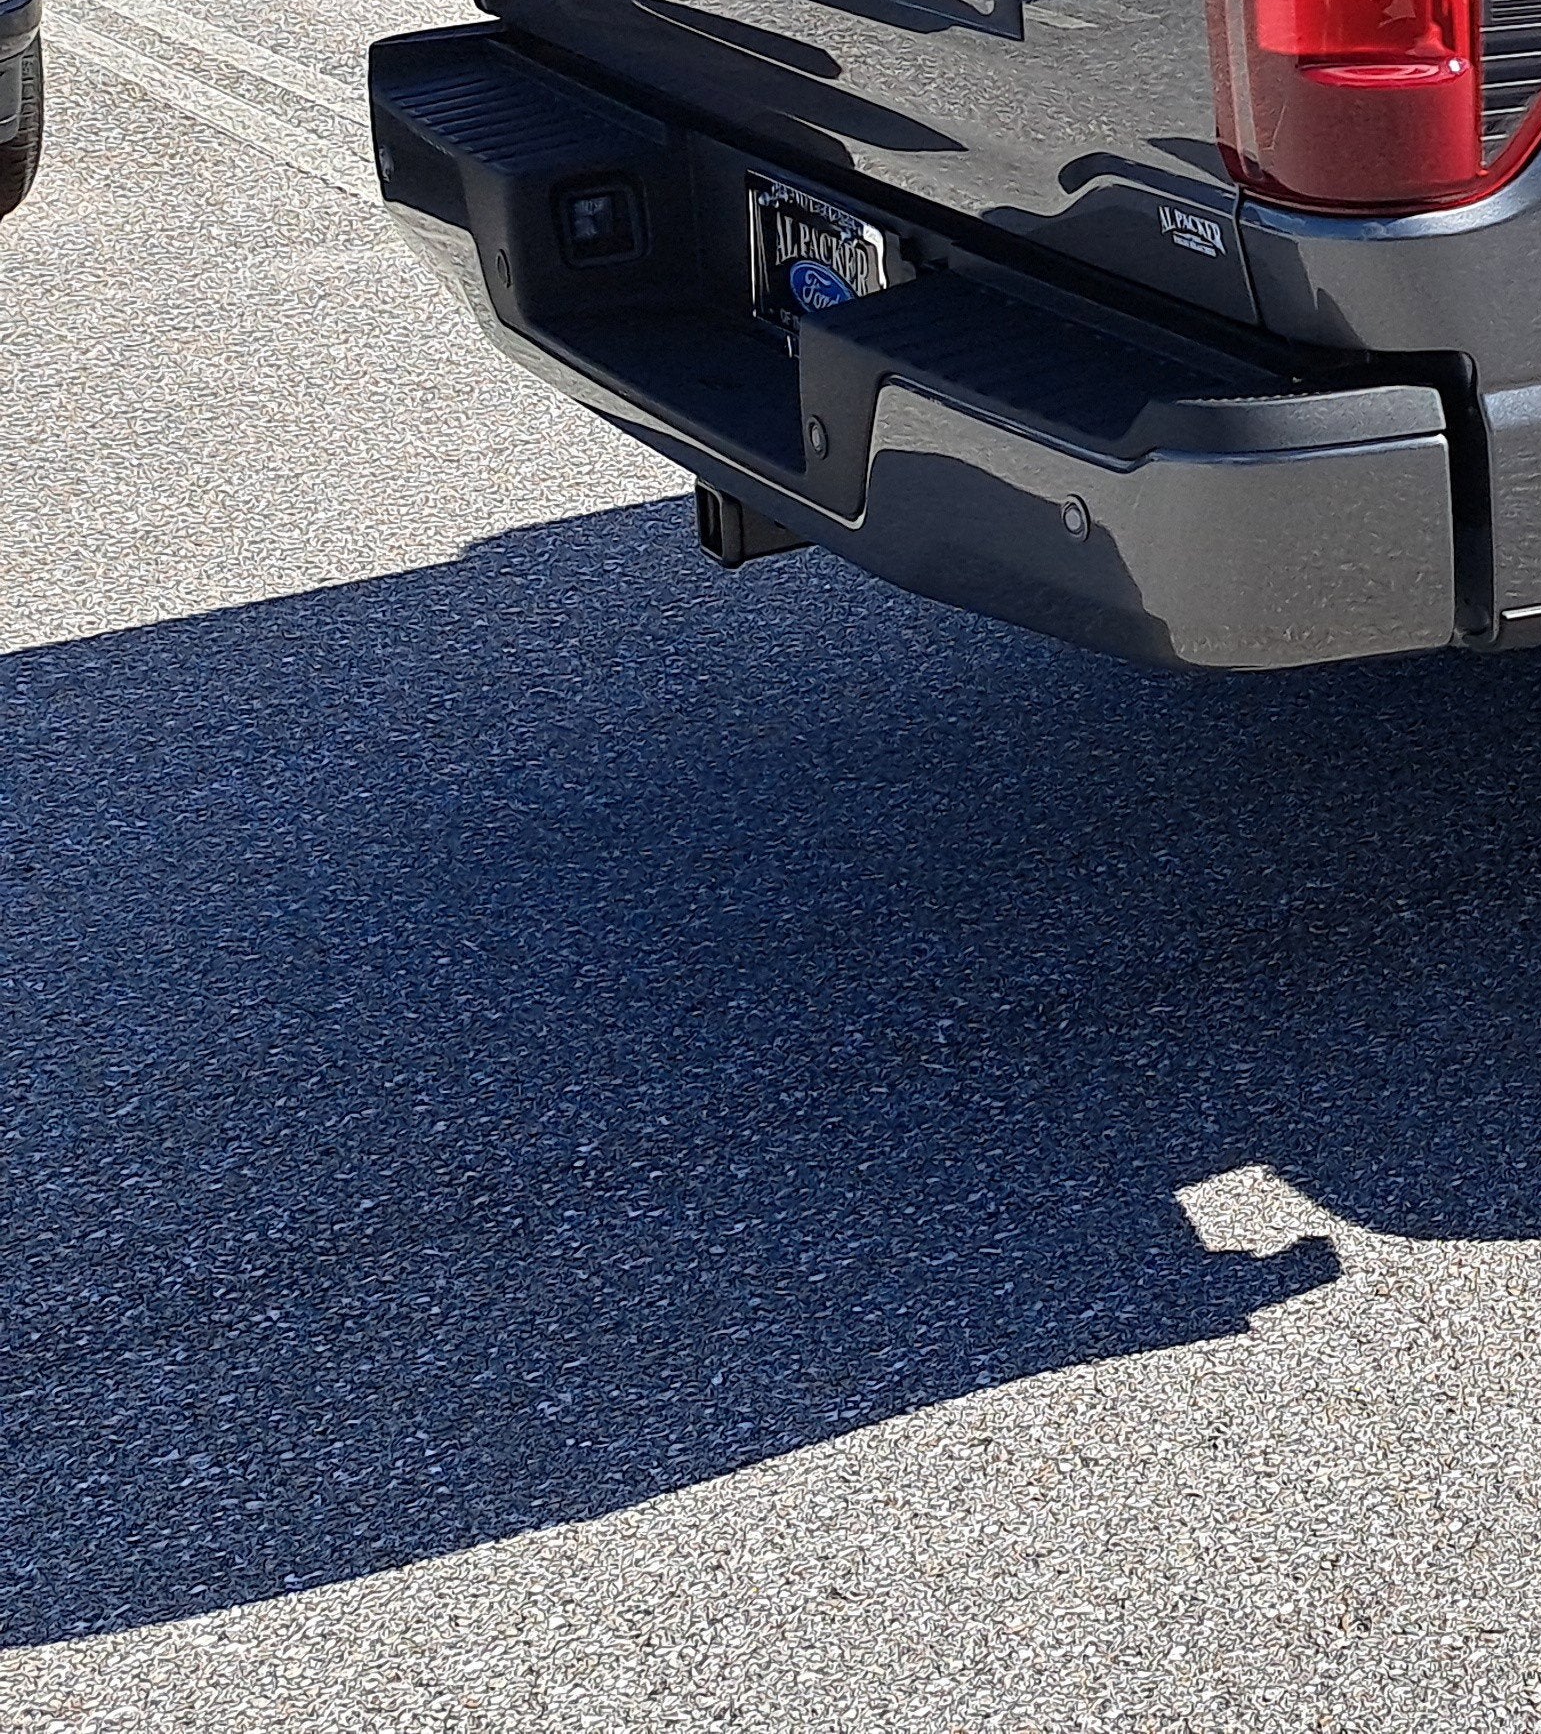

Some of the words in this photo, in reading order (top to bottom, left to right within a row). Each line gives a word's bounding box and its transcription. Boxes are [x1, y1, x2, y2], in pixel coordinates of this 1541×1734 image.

[775, 211, 798, 266] AL
[799, 222, 870, 298] PACKER
[1158, 206, 1176, 235] AL
[1173, 208, 1227, 256] PACKER
